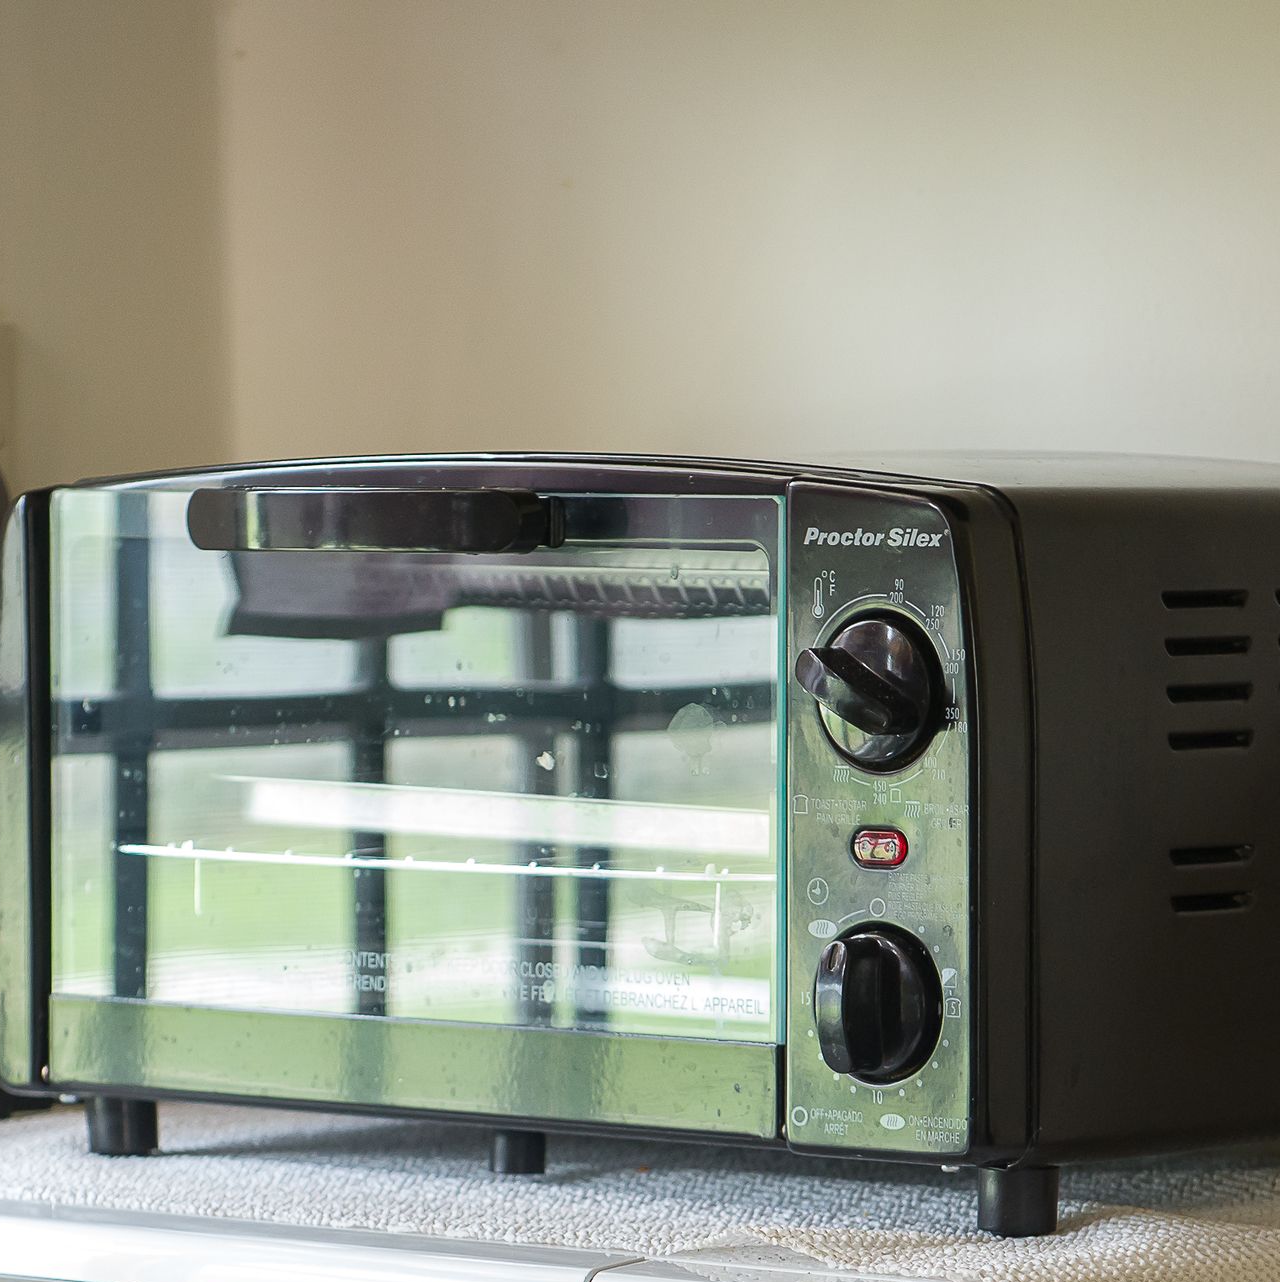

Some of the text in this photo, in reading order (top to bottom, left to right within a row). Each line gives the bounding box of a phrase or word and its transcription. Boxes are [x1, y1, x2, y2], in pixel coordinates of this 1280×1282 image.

[803, 527, 943, 547] Proctor Silex
[829, 584, 836, 597] F
[894, 578, 905, 591] 90
[889, 591, 904, 604] 200
[930, 605, 945, 617] 120
[925, 618, 940, 631] 250
[951, 648, 966, 661] 150
[944, 662, 959, 674] 300
[945, 707, 960, 720] 350
[953, 721, 968, 734] 180
[931, 769, 946, 780] 210
[872, 780, 887, 792] 450
[872, 793, 887, 805] 240
[655, 969, 691, 987] OVEN
[800, 990, 812, 1005] 15
[872, 1090, 883, 1105] 10
